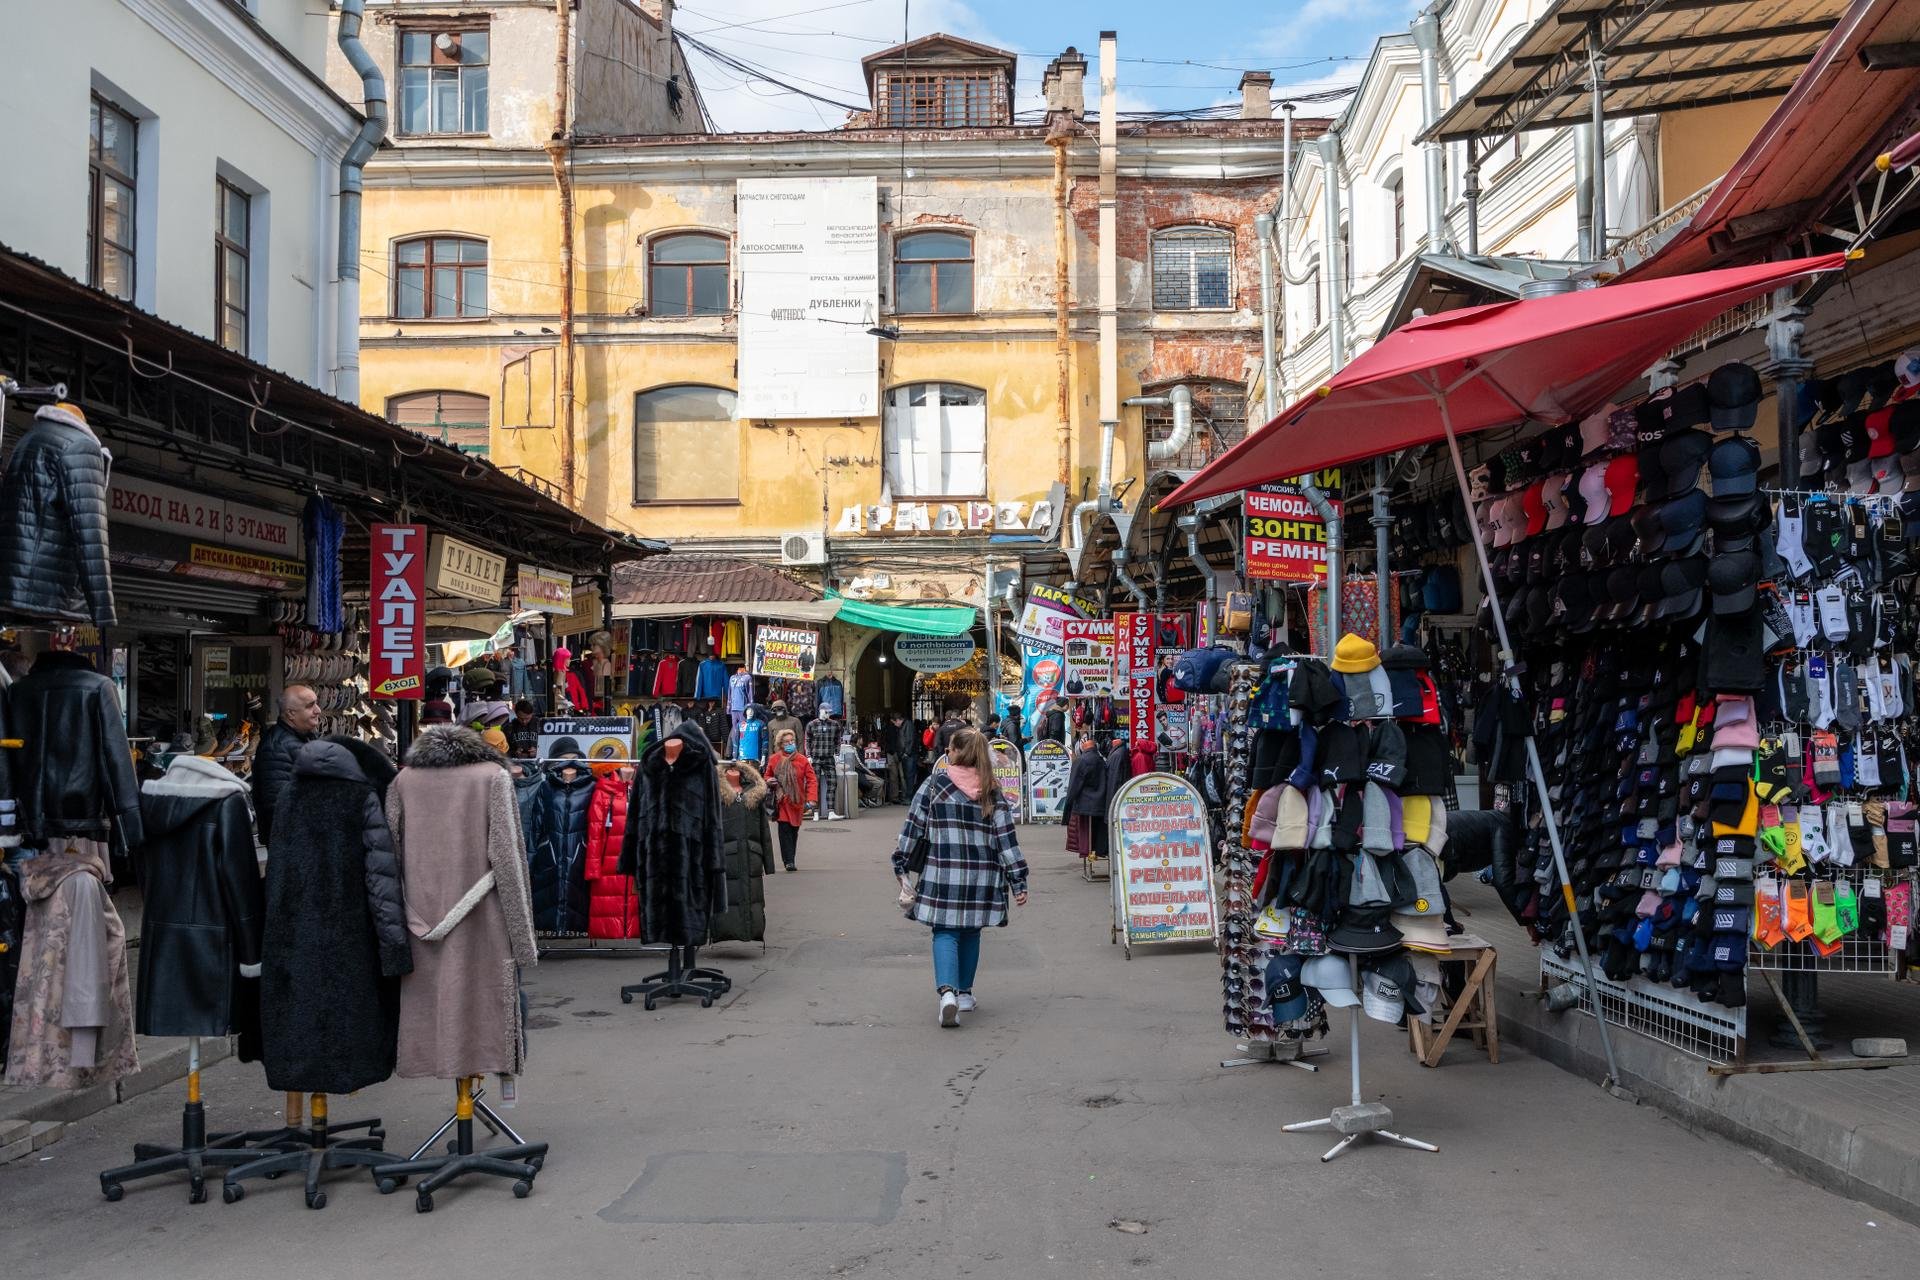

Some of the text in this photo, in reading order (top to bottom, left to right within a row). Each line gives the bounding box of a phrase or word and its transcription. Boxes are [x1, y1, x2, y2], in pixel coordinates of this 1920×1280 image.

[809, 299, 862, 309] ДУБЛЕНКИ
[770, 308, 806, 321] ФИТНЕСС
[1249, 496, 1338, 517] ЧЕМОДА
[112, 488, 287, 545] ВХОД НА 2 И 3 ЭТАЖИ
[193, 548, 234, 566] ДЕТСКАЯ
[235, 555, 271, 571] ОДЕЖДА
[271, 560, 284, 574] 2-й
[446, 545, 501, 583] ТУАЛЕТ
[378, 528, 417, 675] ТУАЛЕТ
[758, 628, 816, 645] ДЖИНСЫ
[1066, 622, 1114, 635] СУМК
[765, 641, 801, 653] КУРТКИ
[1023, 637, 1034, 646] 961
[1034, 640, 1064, 655] 721-51-49
[1132, 616, 1150, 667] СУМКИ
[1105, 647, 1113, 657] 2
[1067, 658, 1110, 666] ЧЕМОДАНЫ
[1079, 668, 1109, 676] КОШЕЛЬКИ
[384, 675, 417, 692] ВХОД
[1132, 678, 1151, 739] РЮКЗАК
[543, 721, 629, 733] ОПТ и Розница
[993, 768, 1019, 777] ЧАСЫ
[1367, 762, 1396, 777] EA7
[1125, 803, 1195, 818] СУМКИ
[1123, 818, 1200, 833] ЧЕМОДАНЫ
[1128, 840, 1202, 860] ЗОНТЫ
[1129, 866, 1204, 884] РЕМНИ
[1129, 890, 1207, 906] КОШЕЛЬКИ
[1132, 912, 1209, 928] ПЕРЧАТКИ
[1130, 931, 1157, 940] САМЫЕ
[1158, 930, 1186, 939] НИЗКИЕ
